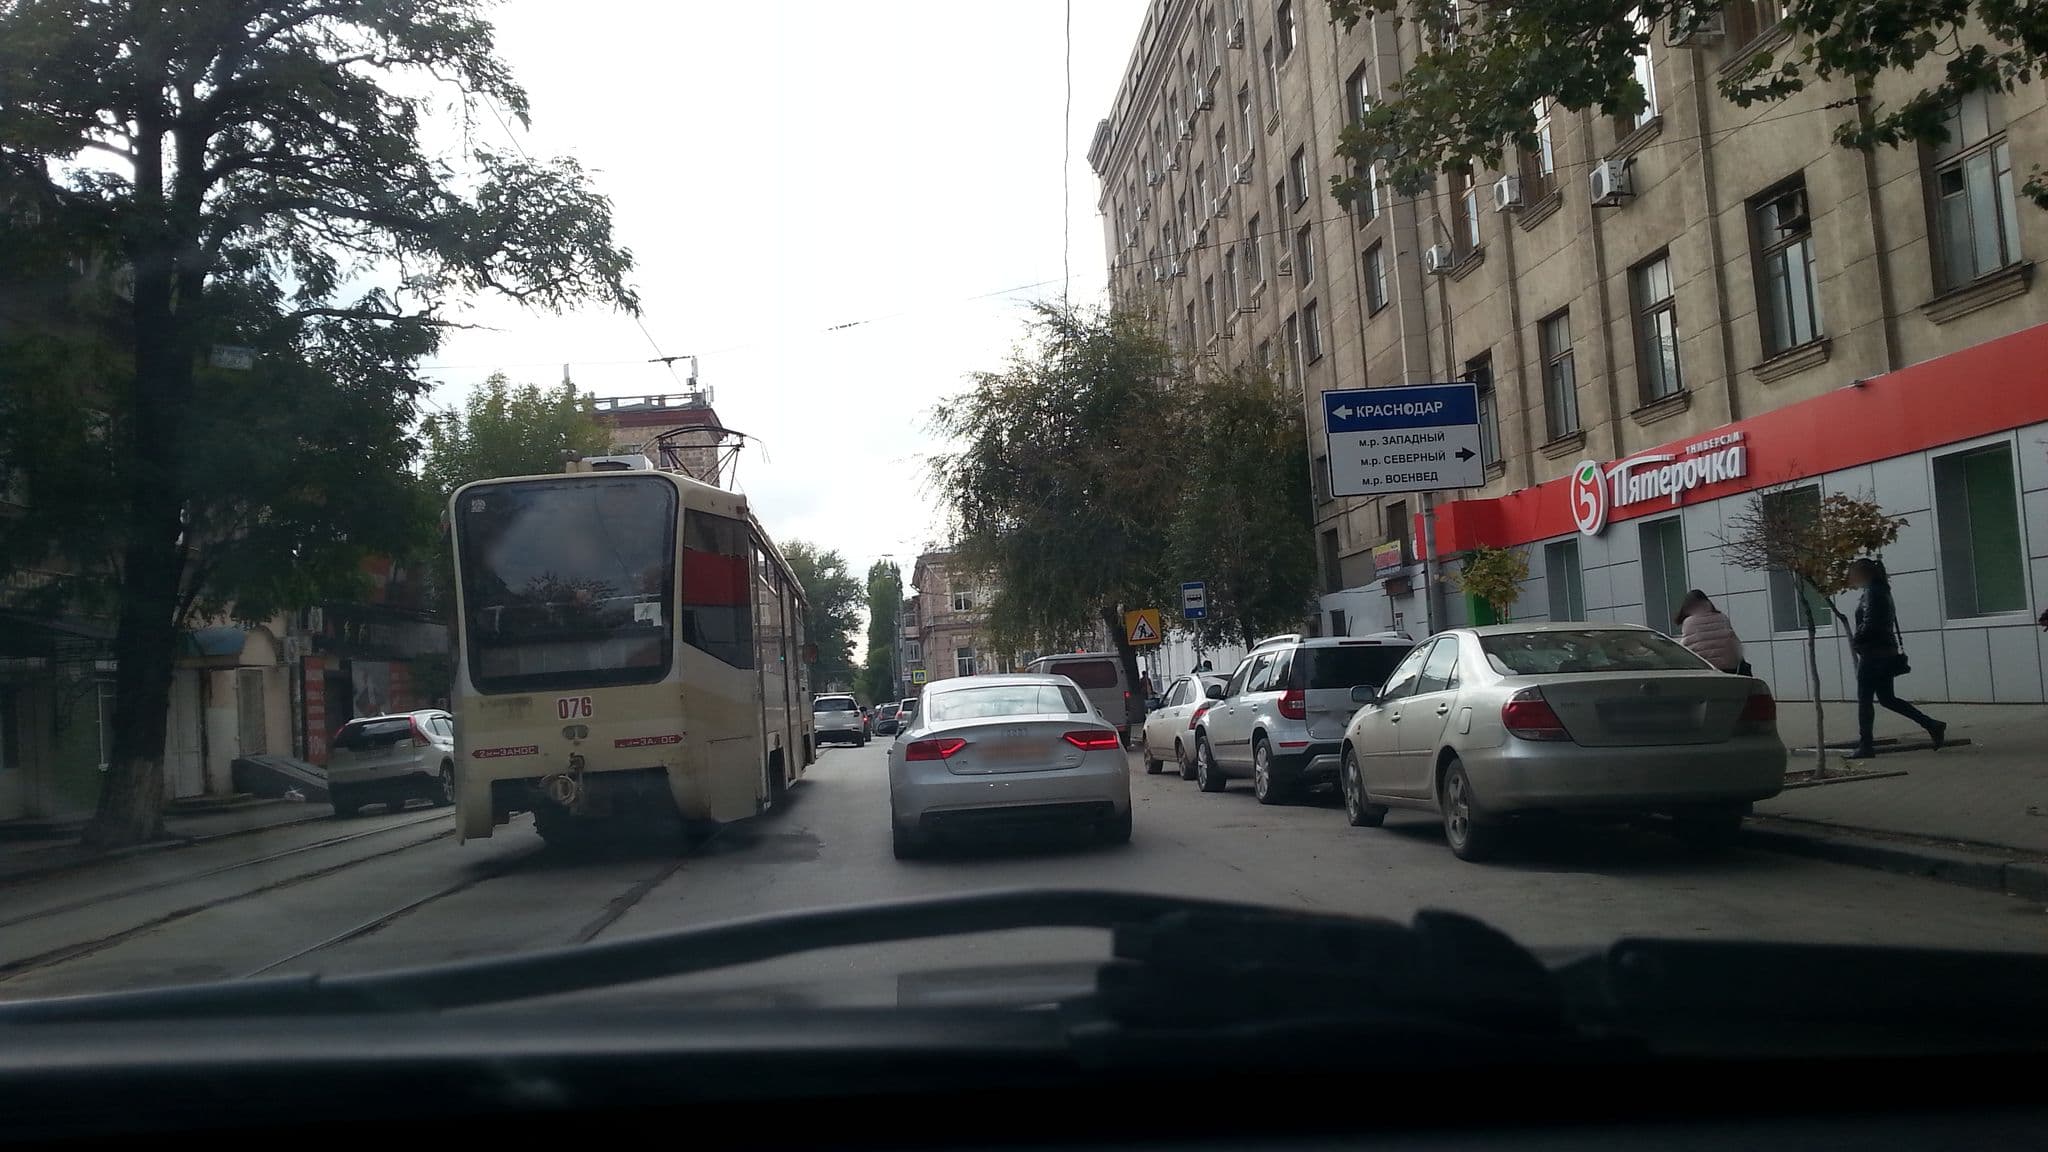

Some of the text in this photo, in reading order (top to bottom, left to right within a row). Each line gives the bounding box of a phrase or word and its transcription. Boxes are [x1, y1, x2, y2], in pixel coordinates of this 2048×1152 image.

[1356, 401, 1443, 418] КРАСНОДАР
[1359, 433, 1445, 448] м.р. ЗАПАДНЫЙ
[1360, 452, 1446, 467] м.р. СЕВЕРНЫЙ
[1362, 471, 1439, 486] м.р. ВОЕНВЕД
[1606, 445, 1746, 505] Пятерочка
[557, 696, 593, 720] 076
